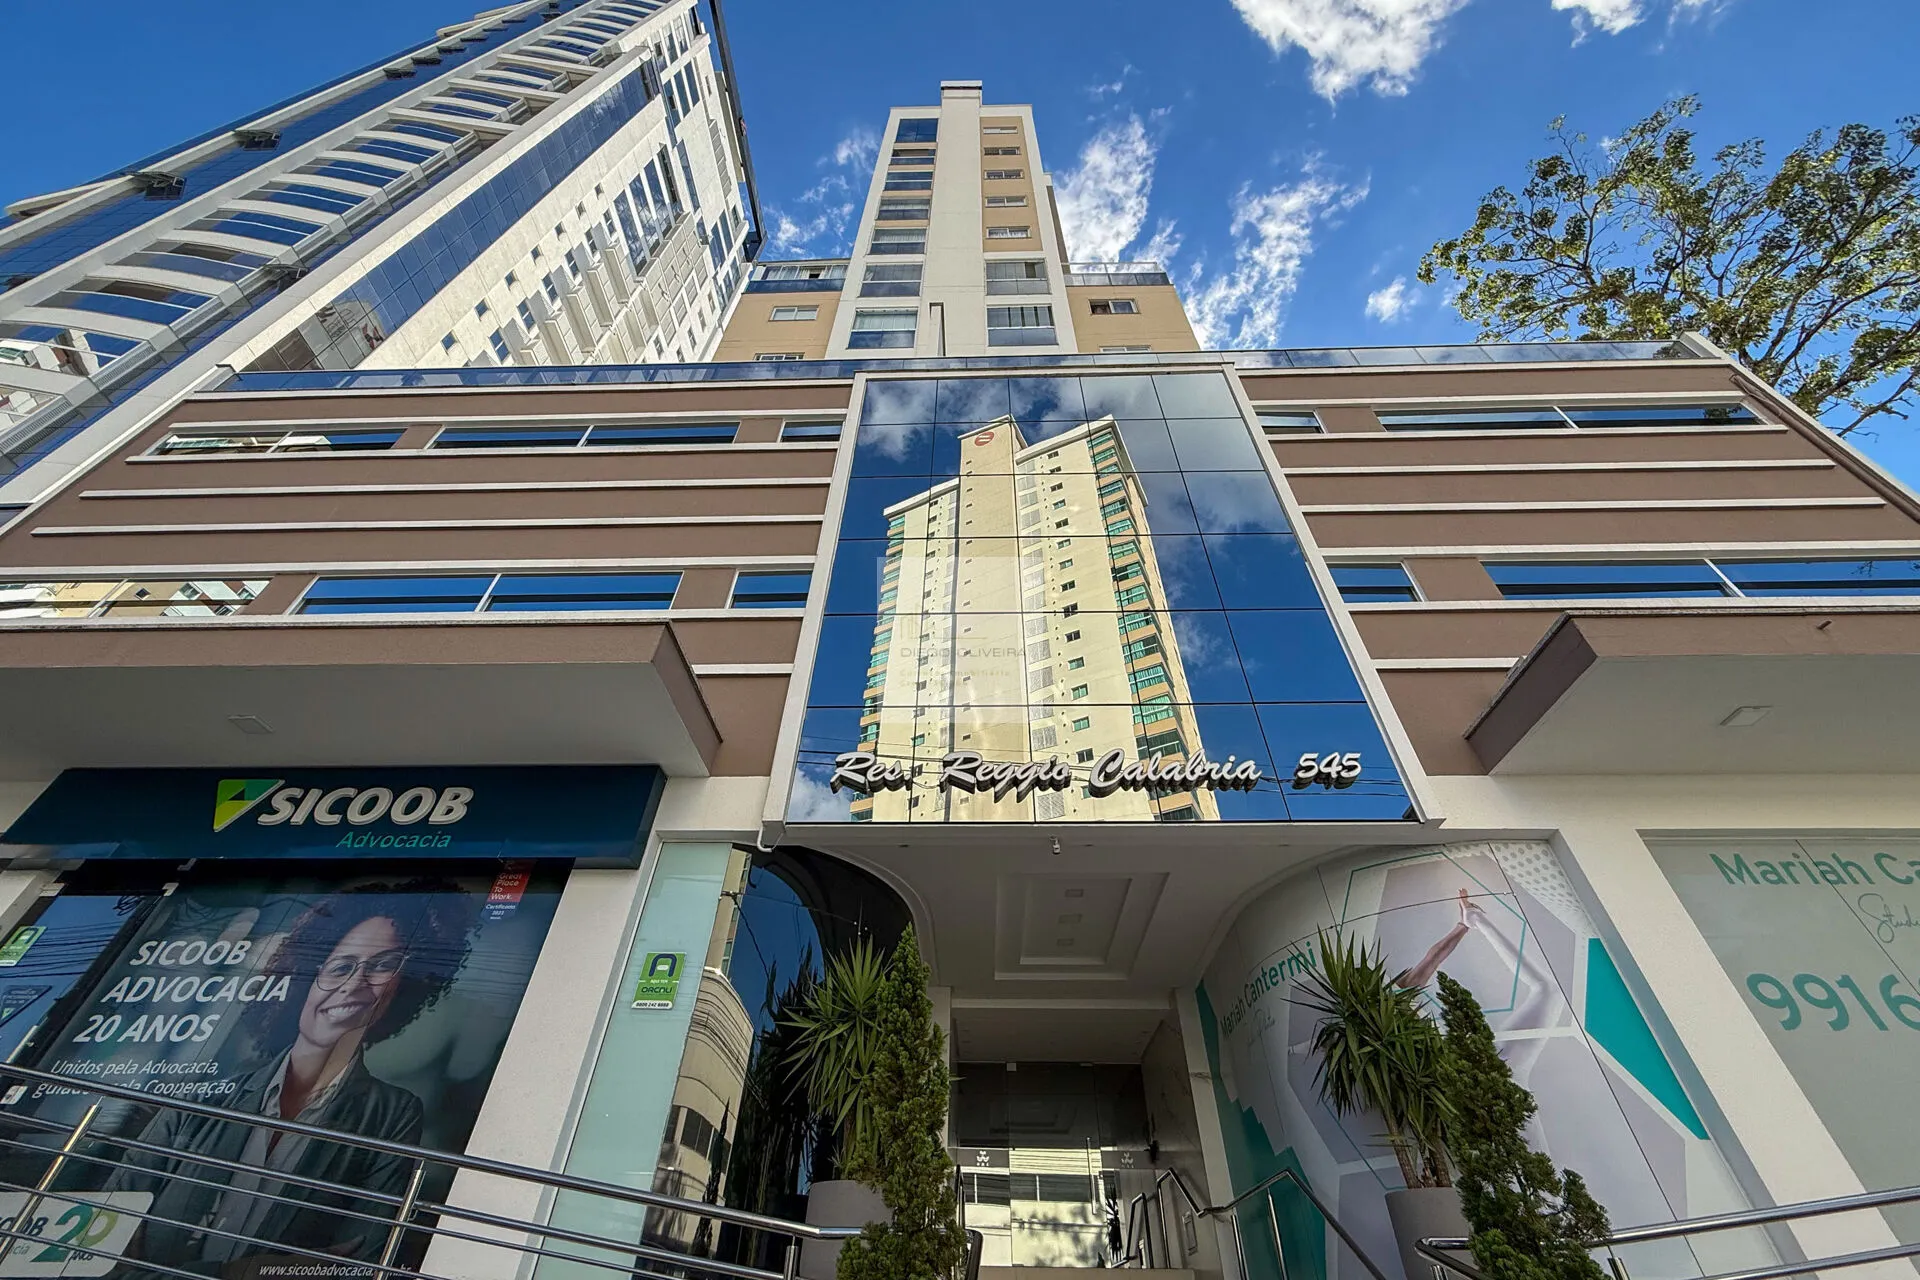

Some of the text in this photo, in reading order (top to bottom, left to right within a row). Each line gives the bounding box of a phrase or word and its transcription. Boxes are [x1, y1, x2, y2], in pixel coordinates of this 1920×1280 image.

[831, 748, 1362, 803] Res. Reggio Calabria 545
[257, 787, 474, 826] SICOOB
[335, 831, 452, 848] Advocacia
[1709, 852, 1876, 885] Mariah
[129, 940, 252, 966] SICOOB
[101, 975, 292, 1002] ADVOCACIA
[72, 1014, 221, 1043] 20 ANOS
[51, 1059, 219, 1078] Unidos pela Advocacia,
[144, 1079, 236, 1098] Cooperação
[30, 1204, 119, 1263] 20
